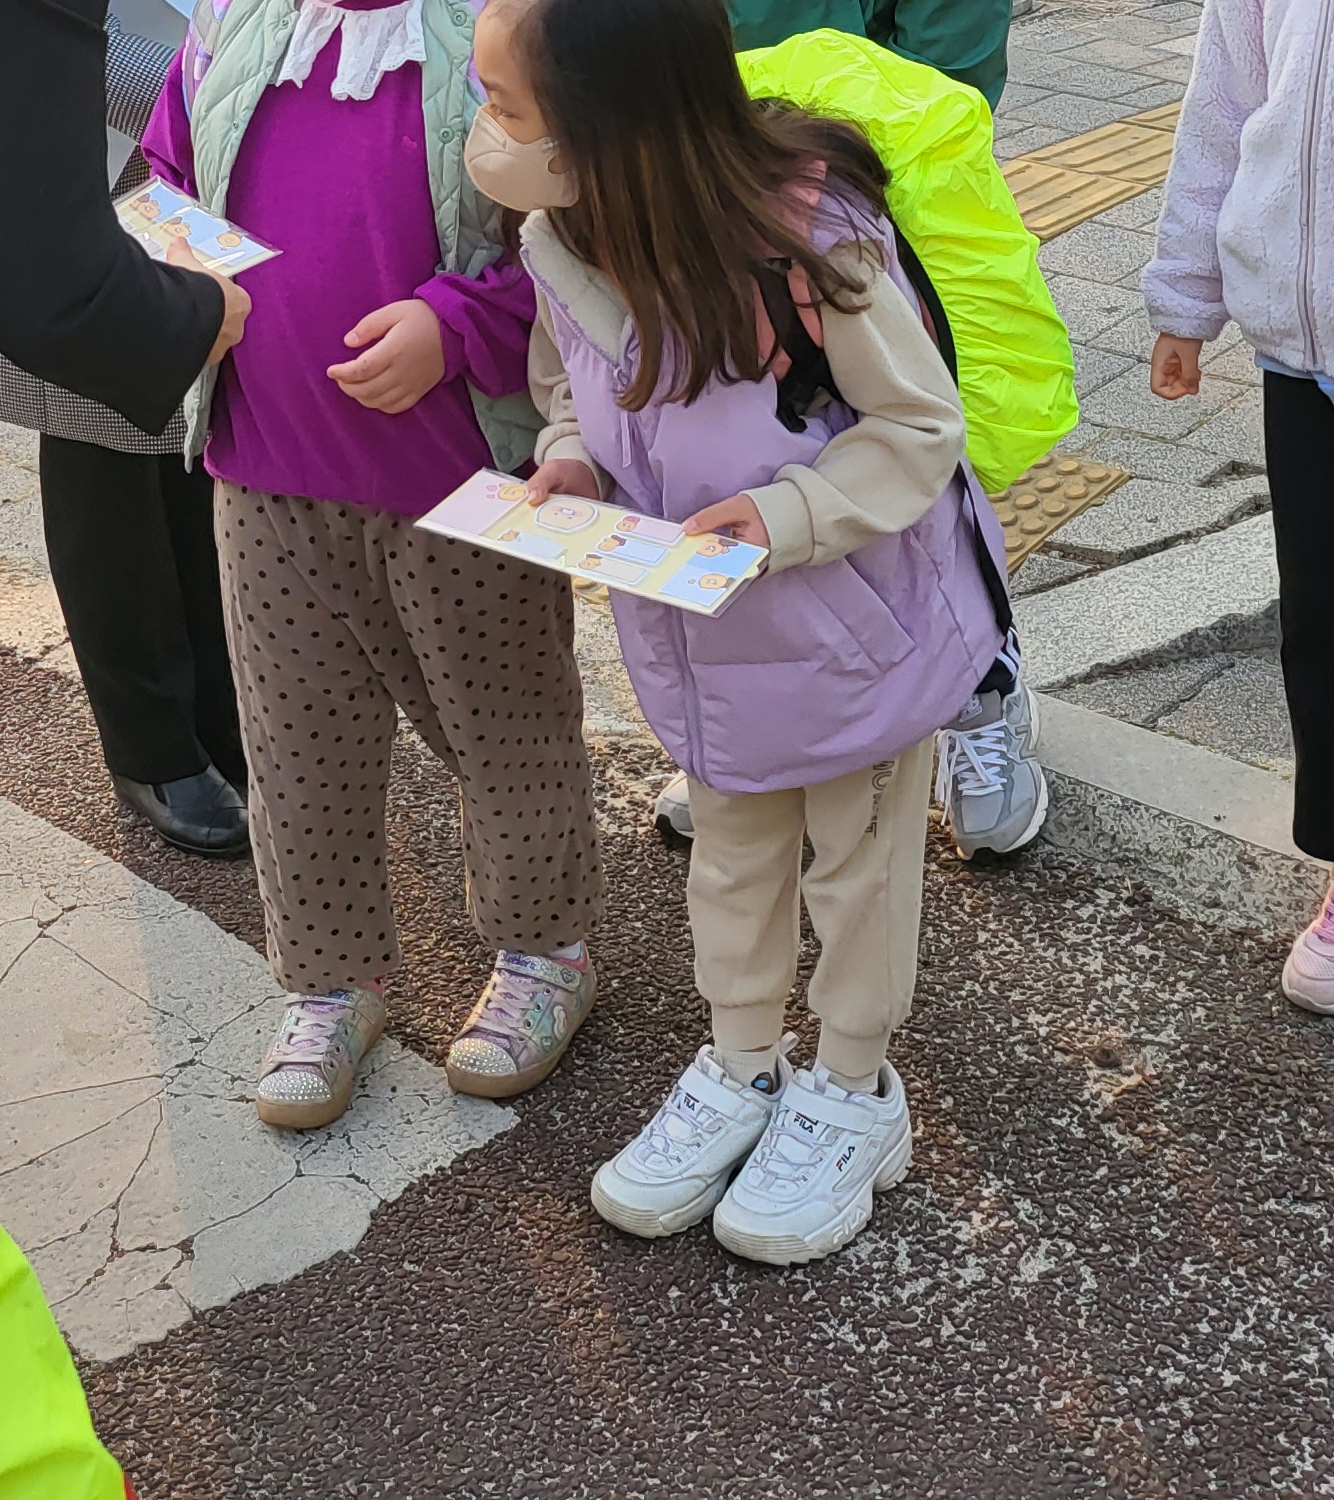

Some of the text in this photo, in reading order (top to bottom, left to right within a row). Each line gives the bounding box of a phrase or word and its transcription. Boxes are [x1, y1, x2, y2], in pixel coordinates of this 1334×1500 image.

[793, 1114, 814, 1134] FILA
[835, 1145, 856, 1172] FILA
[831, 1206, 867, 1245] FILA
